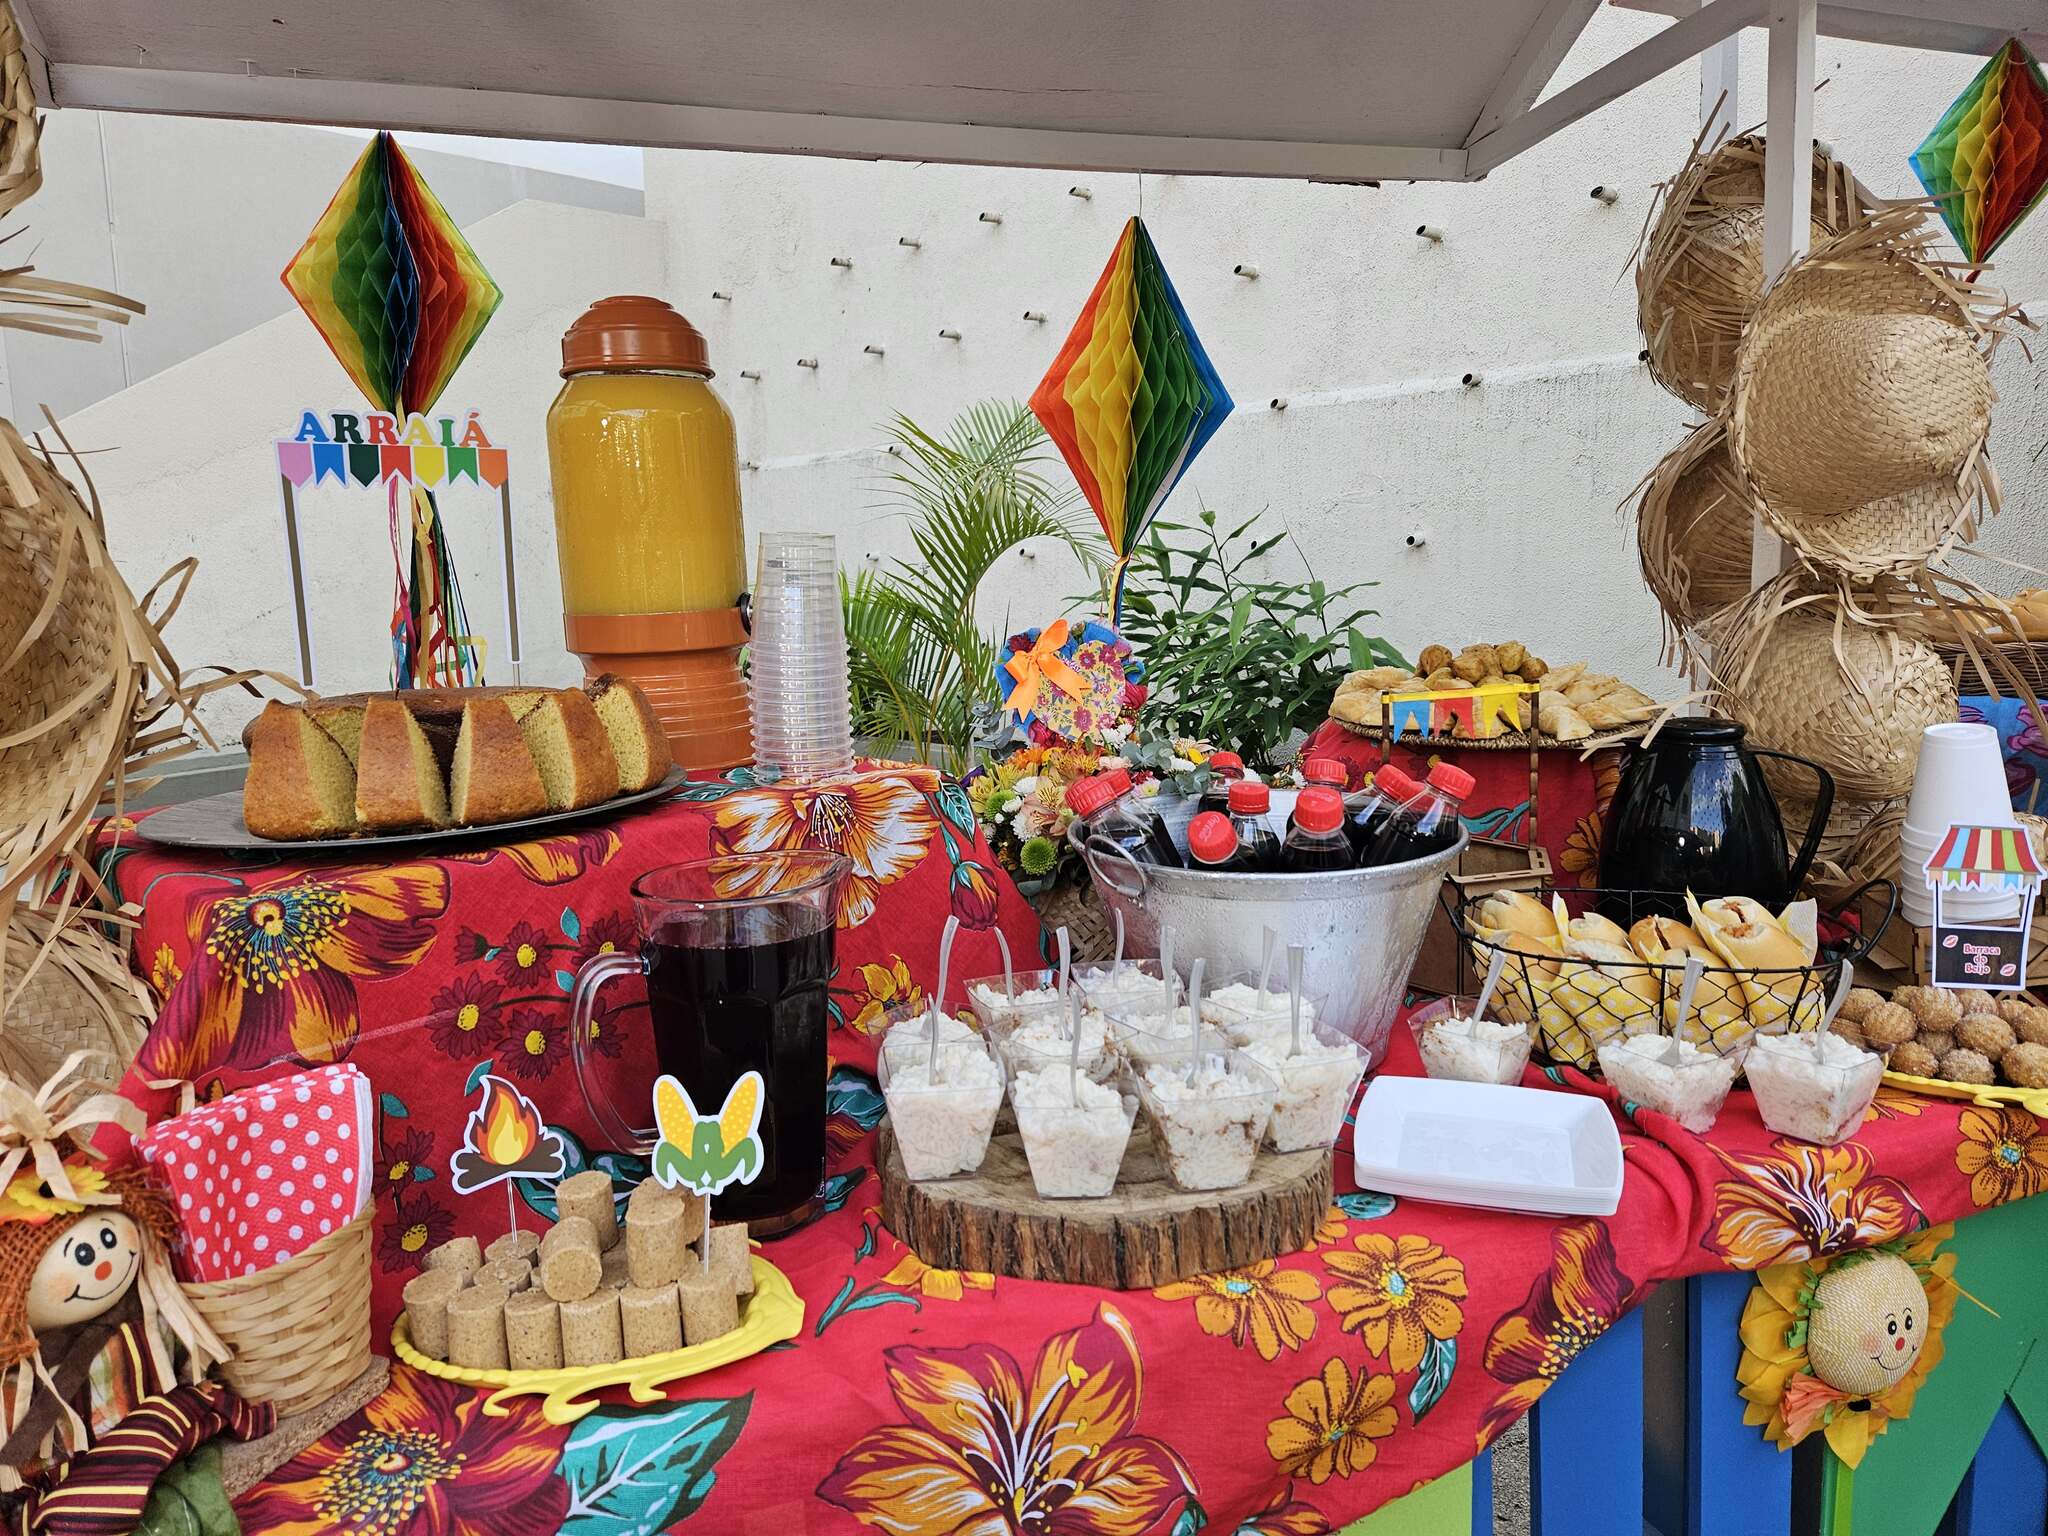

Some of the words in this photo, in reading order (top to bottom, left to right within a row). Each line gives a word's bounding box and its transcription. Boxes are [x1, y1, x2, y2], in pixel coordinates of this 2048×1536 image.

[294, 411, 493, 448] ARRAIÁ
[1963, 943, 2001, 955] Barraca
[1973, 953, 1988, 964] do
[1965, 963, 1991, 975] Beijo
